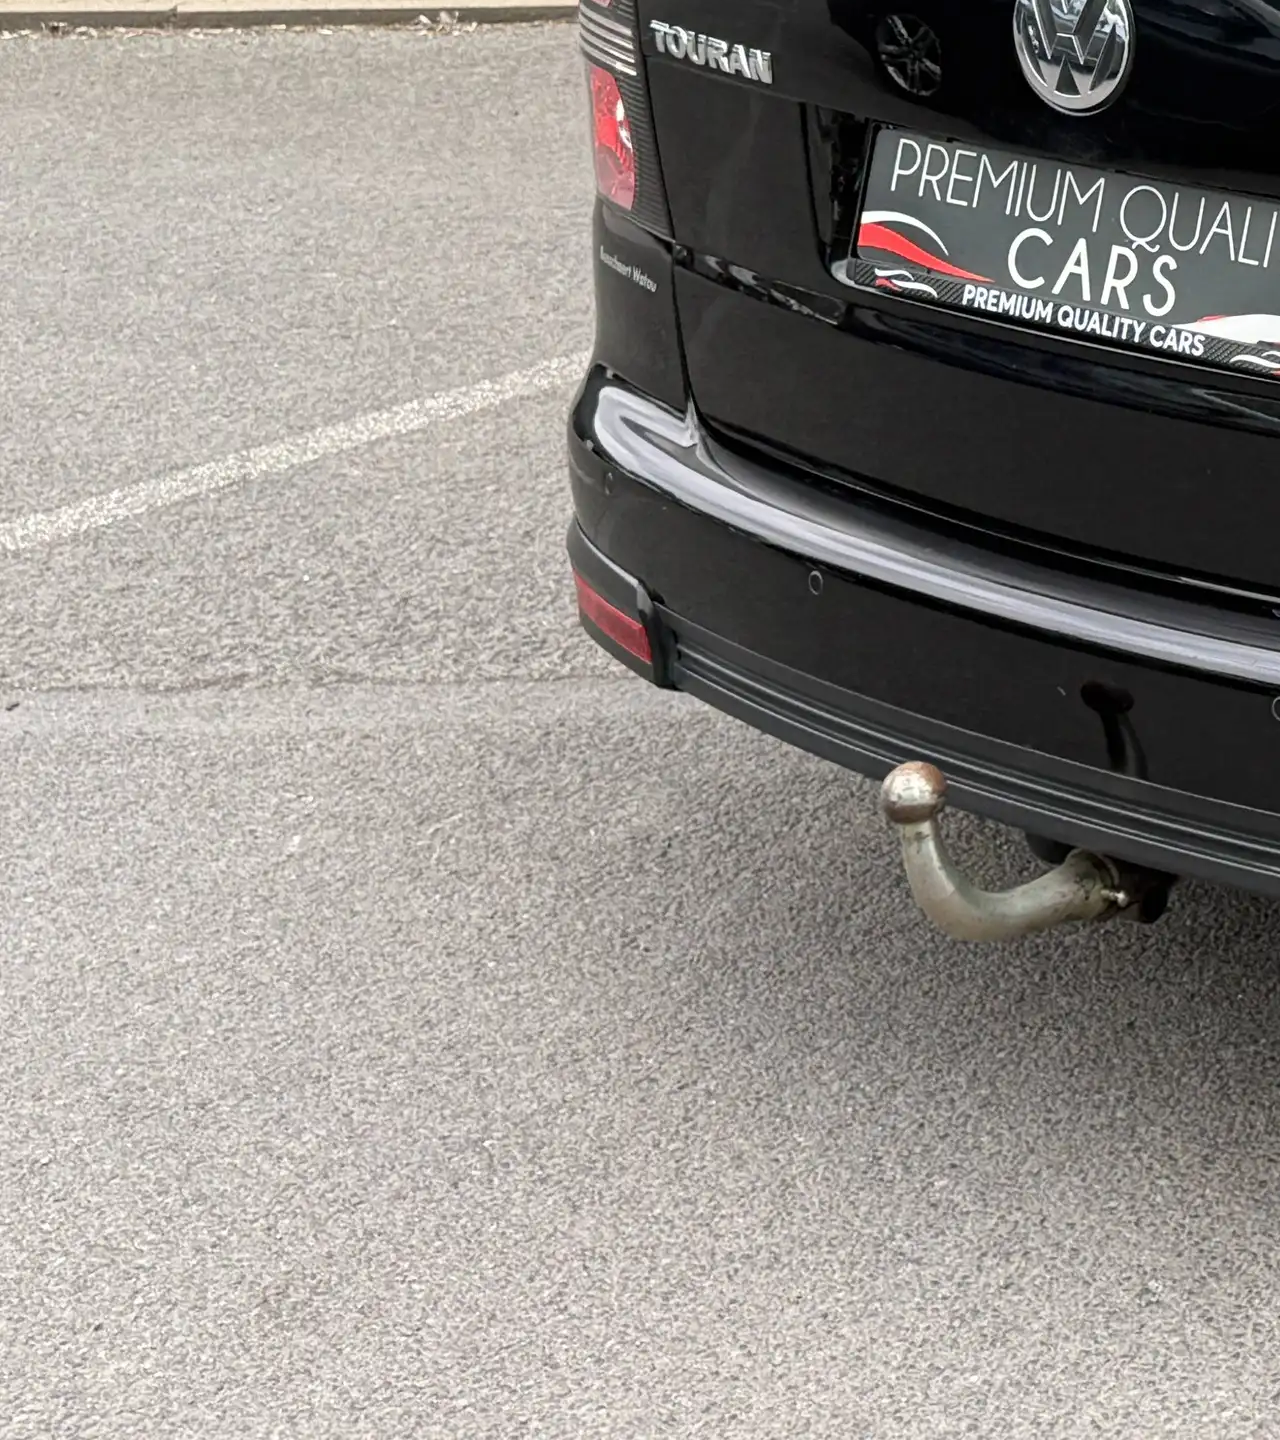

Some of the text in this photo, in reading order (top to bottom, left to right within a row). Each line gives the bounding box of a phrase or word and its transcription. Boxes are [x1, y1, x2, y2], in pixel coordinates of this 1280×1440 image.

[649, 19, 773, 85] TOURAN
[890, 137, 1106, 234] PREMIUM
[1006, 226, 1179, 318] CARS
[962, 282, 1207, 357] PREMIUM QUALITY CARS
